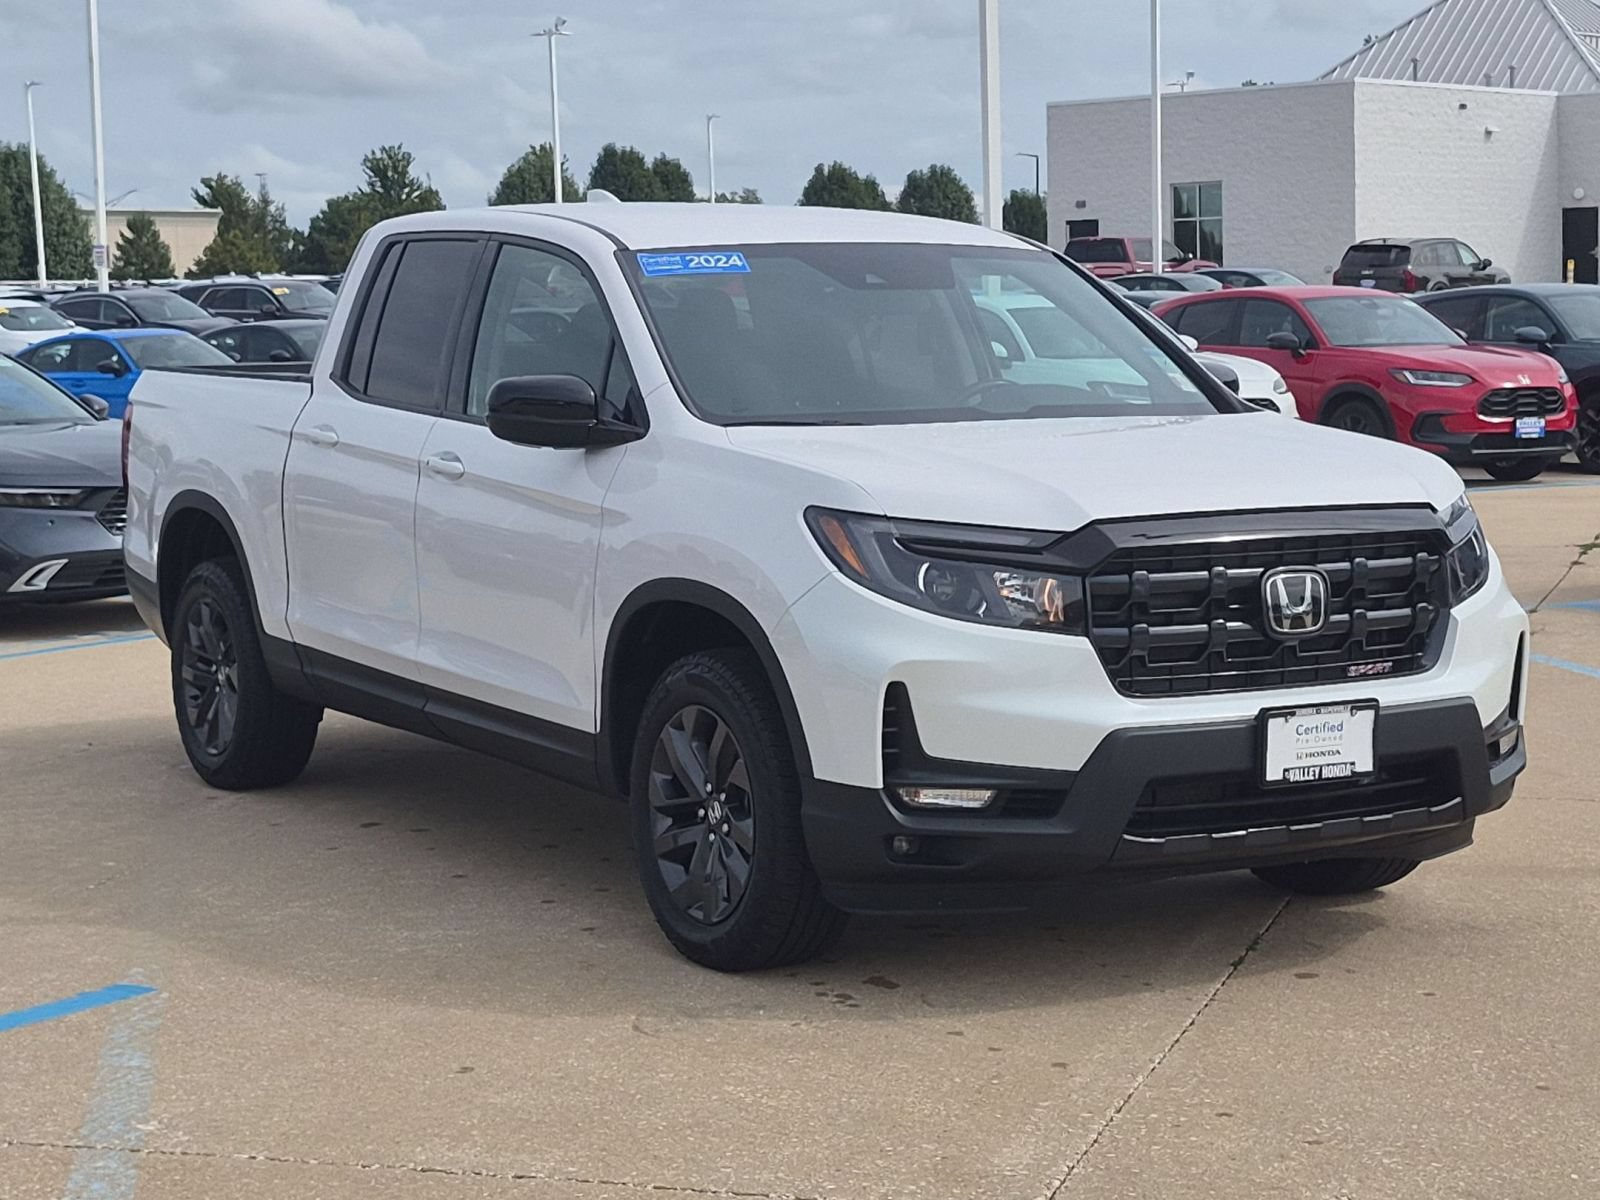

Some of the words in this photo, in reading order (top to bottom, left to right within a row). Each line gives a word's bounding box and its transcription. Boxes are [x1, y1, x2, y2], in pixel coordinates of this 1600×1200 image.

[686, 254, 743, 268] 2024
[1347, 661, 1392, 677] SPORT
[1295, 720, 1344, 736] Certified
[1305, 749, 1342, 759] HONDA
[1289, 766, 1320, 782] VALLEY
[1321, 763, 1352, 779] HONDA
